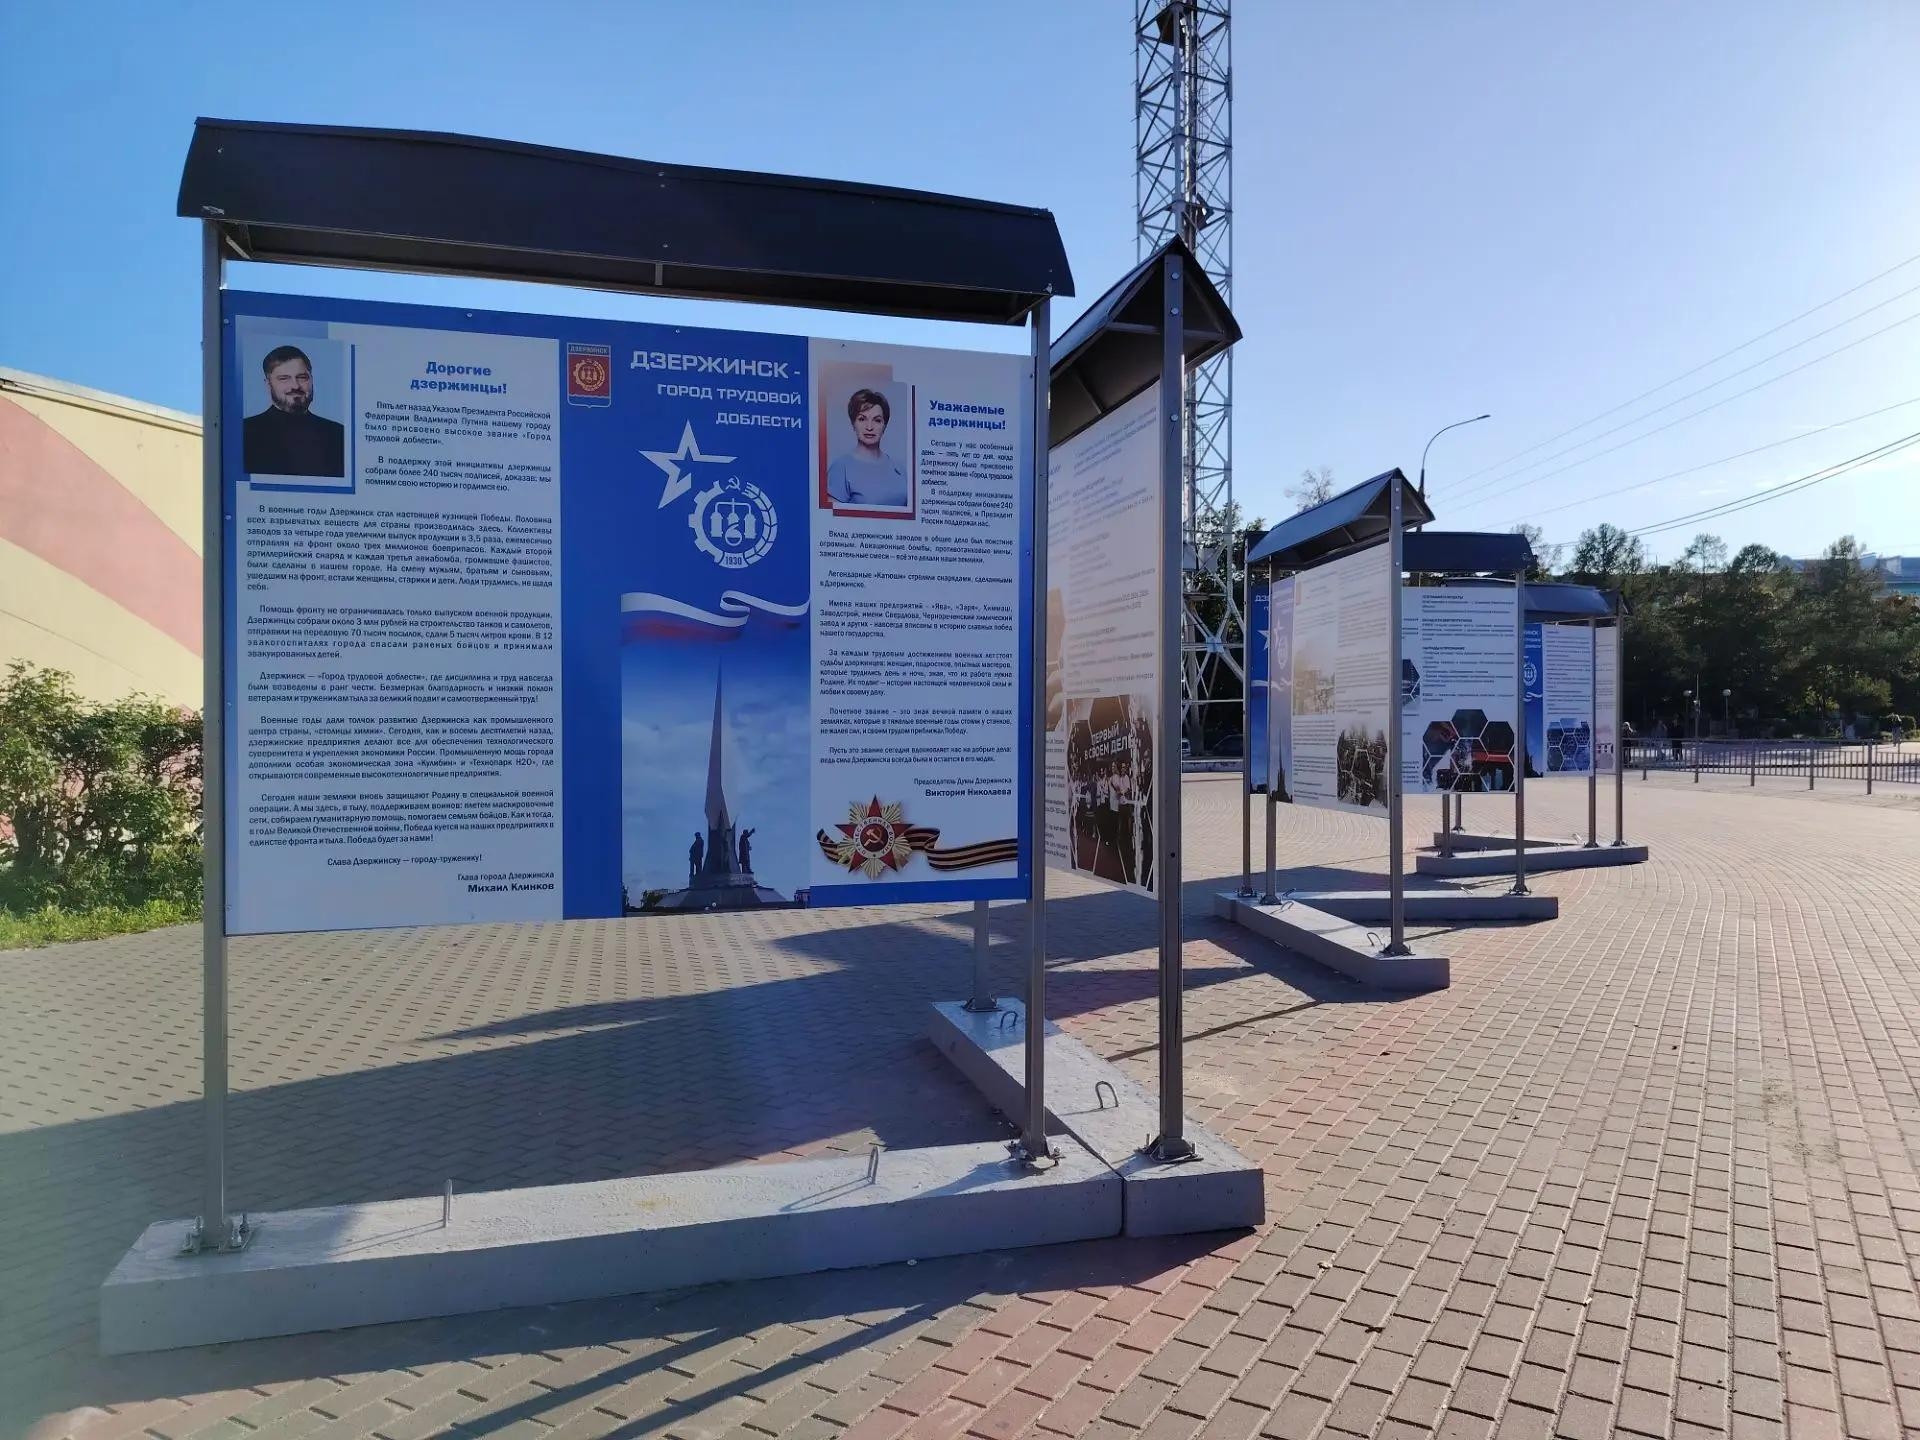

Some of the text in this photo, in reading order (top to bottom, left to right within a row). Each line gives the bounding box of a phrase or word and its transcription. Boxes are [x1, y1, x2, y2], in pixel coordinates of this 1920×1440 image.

[425, 361, 492, 377] Дорогие
[630, 351, 789, 379] ДЗЕРЖИНСК
[410, 379, 507, 395] дзержинцы!
[657, 383, 802, 405] ГОРОД ТРУДОВОЙ
[408, 404, 432, 413] назад
[432, 404, 461, 414] Указом
[461, 406, 506, 420] Президента
[506, 409, 551, 420] Российской
[929, 400, 1006, 416] Уважаемые
[364, 411, 551, 433] Федерации Владимира Путина нашему городу
[715, 412, 802, 429] ДОБЛЕСТИ
[929, 415, 1006, 431] дзержинцы!
[364, 420, 388, 432] было
[391, 424, 441, 437] присвоено
[444, 427, 483, 437] высокое
[486, 430, 519, 439] звание
[364, 434, 401, 443] трудовой
[388, 457, 432, 469] поддержку
[434, 457, 453, 468] этой
[456, 461, 504, 470] инициативы
[364, 465, 397, 476] собрали
[398, 467, 422, 476] более
[439, 470, 463, 479] тысяч
[463, 472, 503, 481] подписей,
[365, 478, 397, 486] помним
[397, 479, 419, 488] свою
[418, 481, 453, 489] историю
[459, 482, 496, 491] гордимся
[268, 506, 305, 514] военные
[307, 507, 327, 516] годы
[329, 507, 375, 517] Дзержинск
[376, 510, 394, 518] стал
[395, 511, 440, 520] настоящей
[441, 512, 478, 522] кузницей
[515, 514, 552, 524] Половина
[246, 516, 267, 524] всех
[269, 517, 321, 526] взрывчатых
[323, 519, 360, 527] веществ
[380, 521, 411, 530] страны
[413, 522, 475, 534] производилась
[507, 524, 552, 535] Коллективы
[245, 539, 290, 548] отправляя
[307, 539, 333, 549] фронт
[336, 541, 360, 549] около
[363, 542, 382, 551] трех
[384, 543, 429, 551] миллионов
[490, 545, 522, 555] Каждый
[525, 547, 553, 557] второй
[725, 556, 742, 565] 1930
[247, 582, 269, 591] себя.
[247, 639, 329, 647] эвакогоспиталях
[332, 640, 367, 650] города
[412, 641, 453, 650] раненых
[456, 640, 490, 651] бойцов
[503, 643, 553, 651] принимали
[247, 650, 317, 660] эвакуированных
[260, 715, 299, 724] Военные
[301, 717, 323, 725] годы
[325, 717, 345, 725] дали
[378, 717, 419, 726] развитию
[420, 715, 470, 725] Дзержинска
[490, 717, 554, 726] промышленного
[248, 739, 304, 748] дзержинские
[307, 739, 361, 748] предприятия
[363, 738, 393, 746] делают
[431, 736, 483, 746] обеспечения
[248, 772, 304, 781] открываются
[303, 771, 361, 780] современные
[361, 771, 449, 779] высокотехнологичные
[924, 787, 1012, 799] Виктория Николаева
[248, 838, 288, 849] единстве
[287, 837, 318, 847] фронта
[346, 834, 377, 844] Победа
[377, 834, 399, 845] будет
[409, 833, 436, 842] нами!
[467, 882, 555, 893] Михаил Клинков
